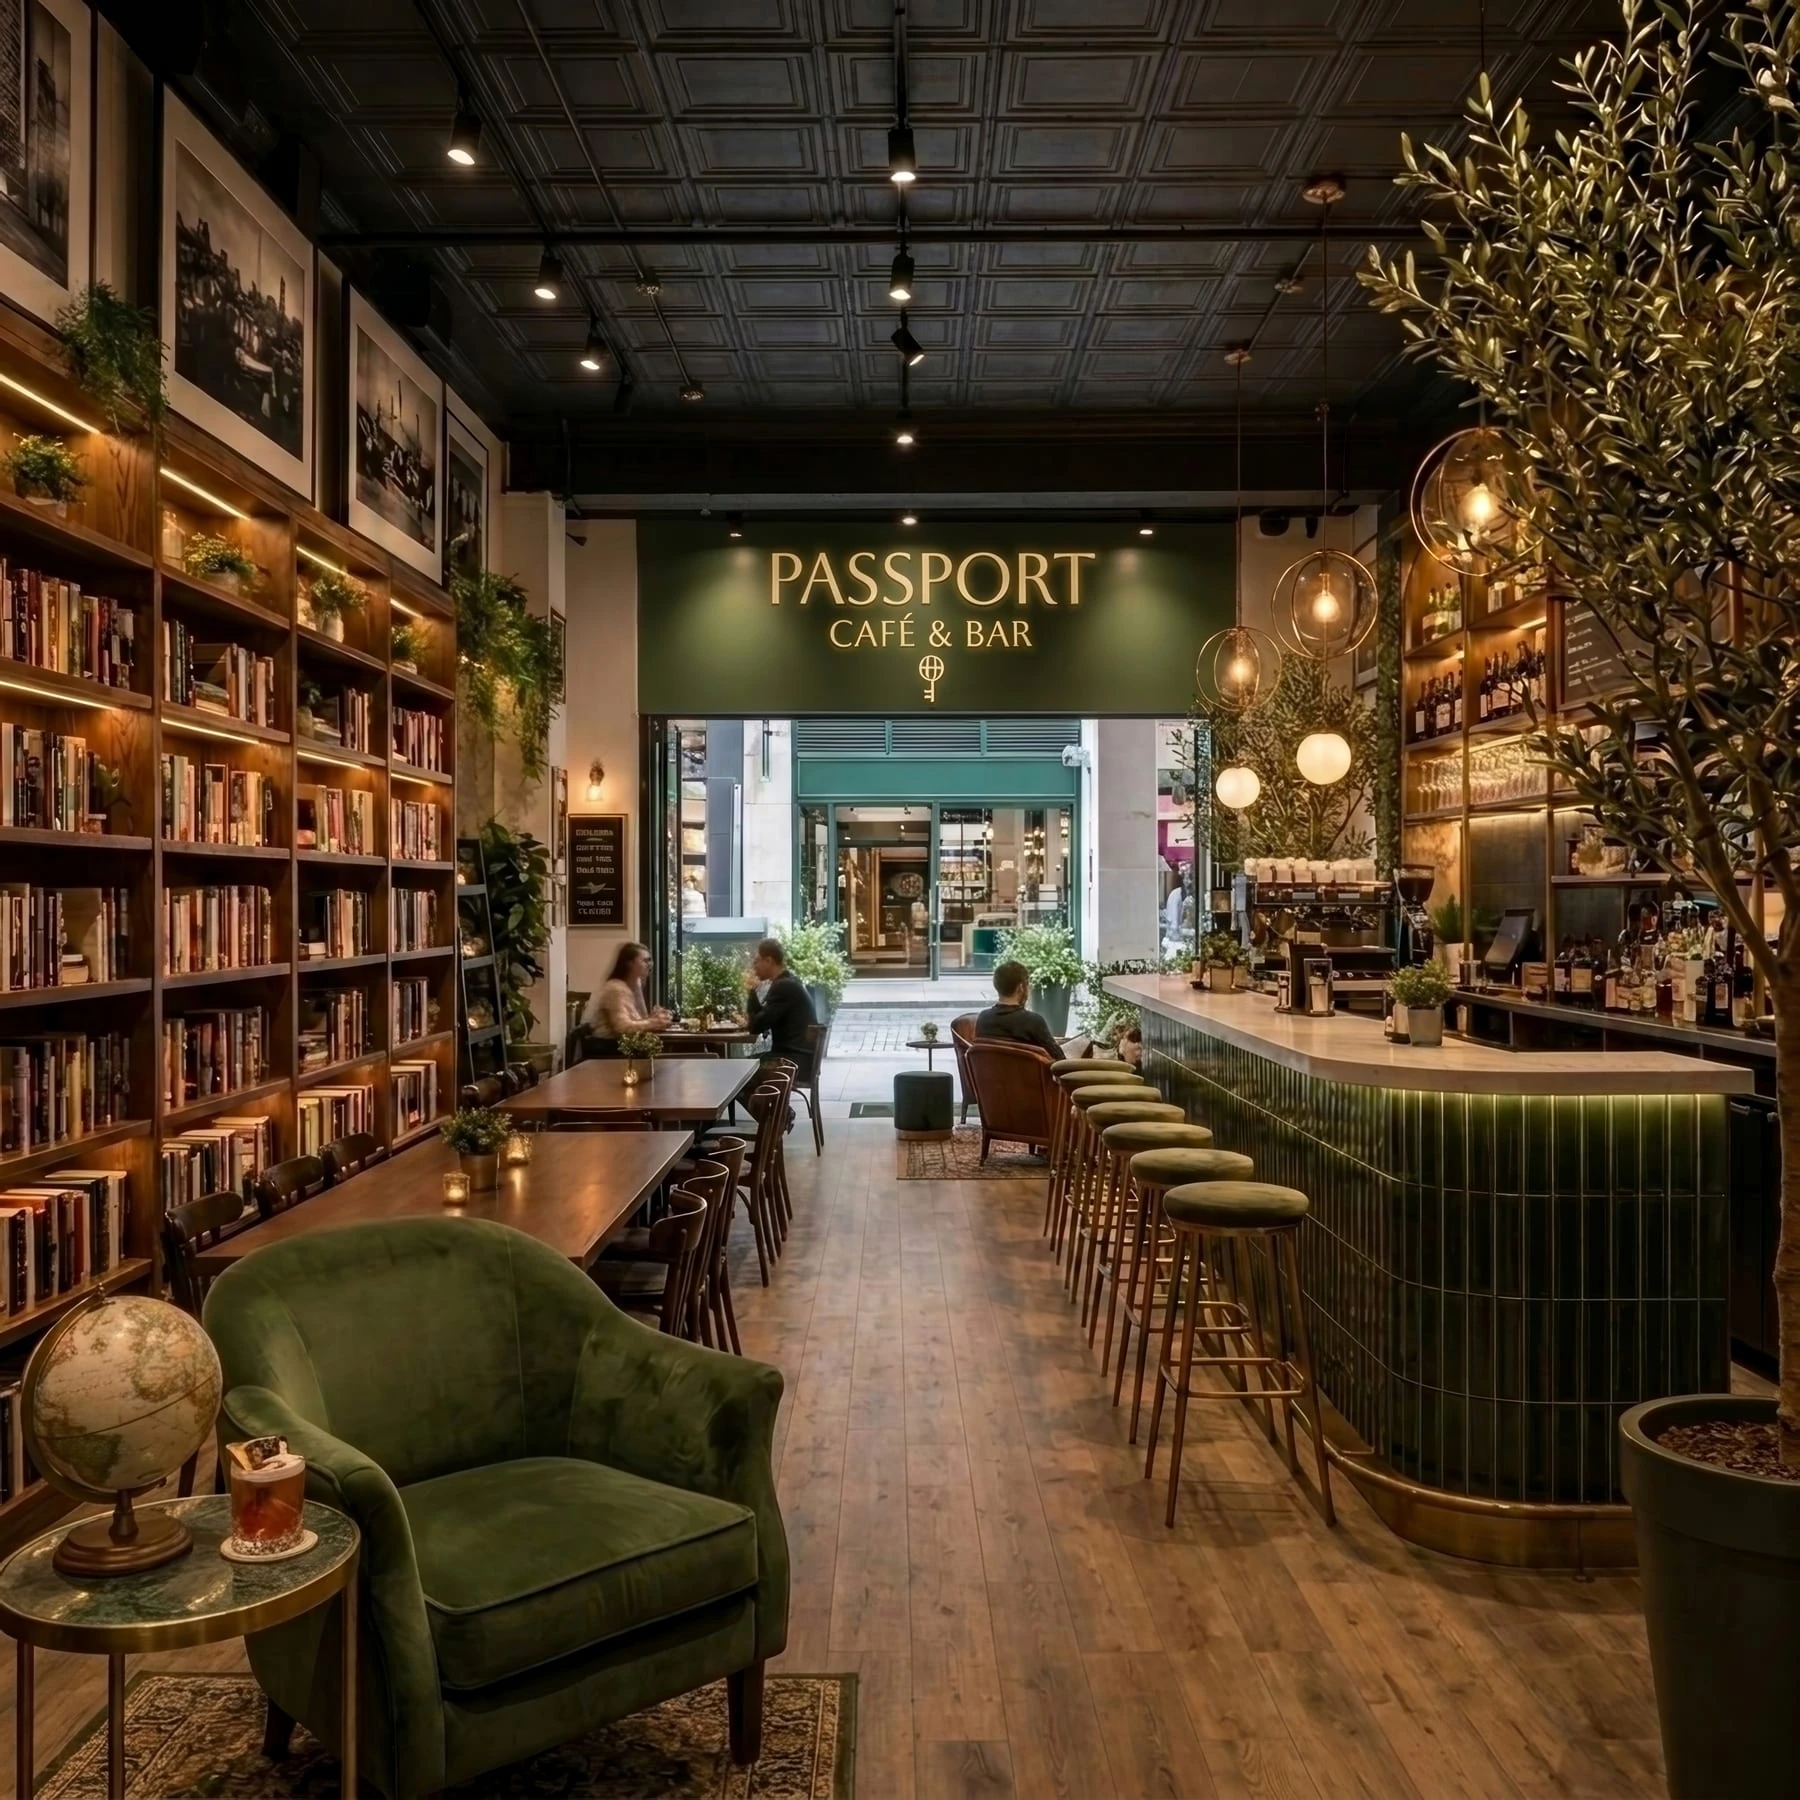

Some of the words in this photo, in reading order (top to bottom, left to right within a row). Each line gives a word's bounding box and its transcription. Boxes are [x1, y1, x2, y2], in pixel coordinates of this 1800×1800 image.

[770, 551, 1096, 606] PASSPORT
[829, 612, 915, 649] CAFÉ
[928, 619, 953, 649] &
[966, 620, 1033, 648] BAR
